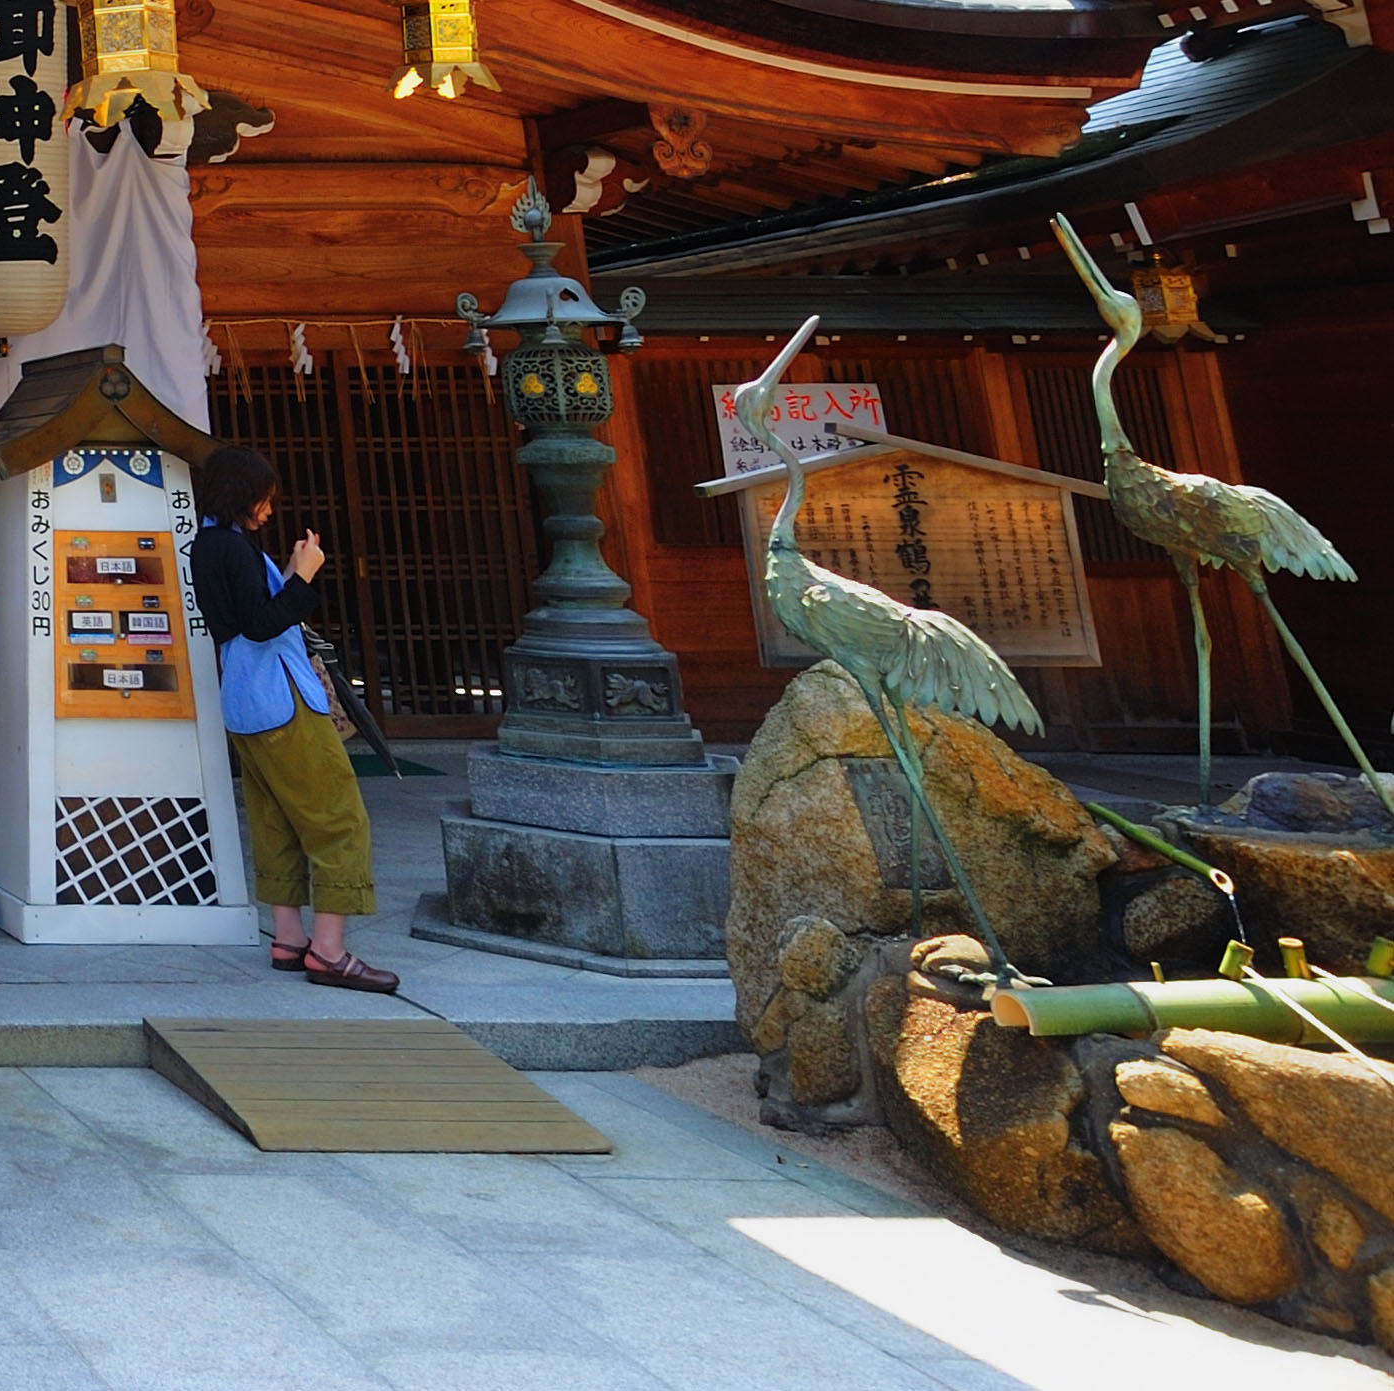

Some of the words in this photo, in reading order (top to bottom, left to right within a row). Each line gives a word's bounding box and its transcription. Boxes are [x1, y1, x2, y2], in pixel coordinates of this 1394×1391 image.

[720, 388, 880, 426] 記入所
[31, 489, 51, 637] おみくじ30円
[100, 561, 134, 573] 日本語
[171, 489, 208, 637] おみく3円
[81, 615, 104, 628] 英語
[131, 616, 165, 629] 韓国語
[107, 671, 141, 685] 日本語
